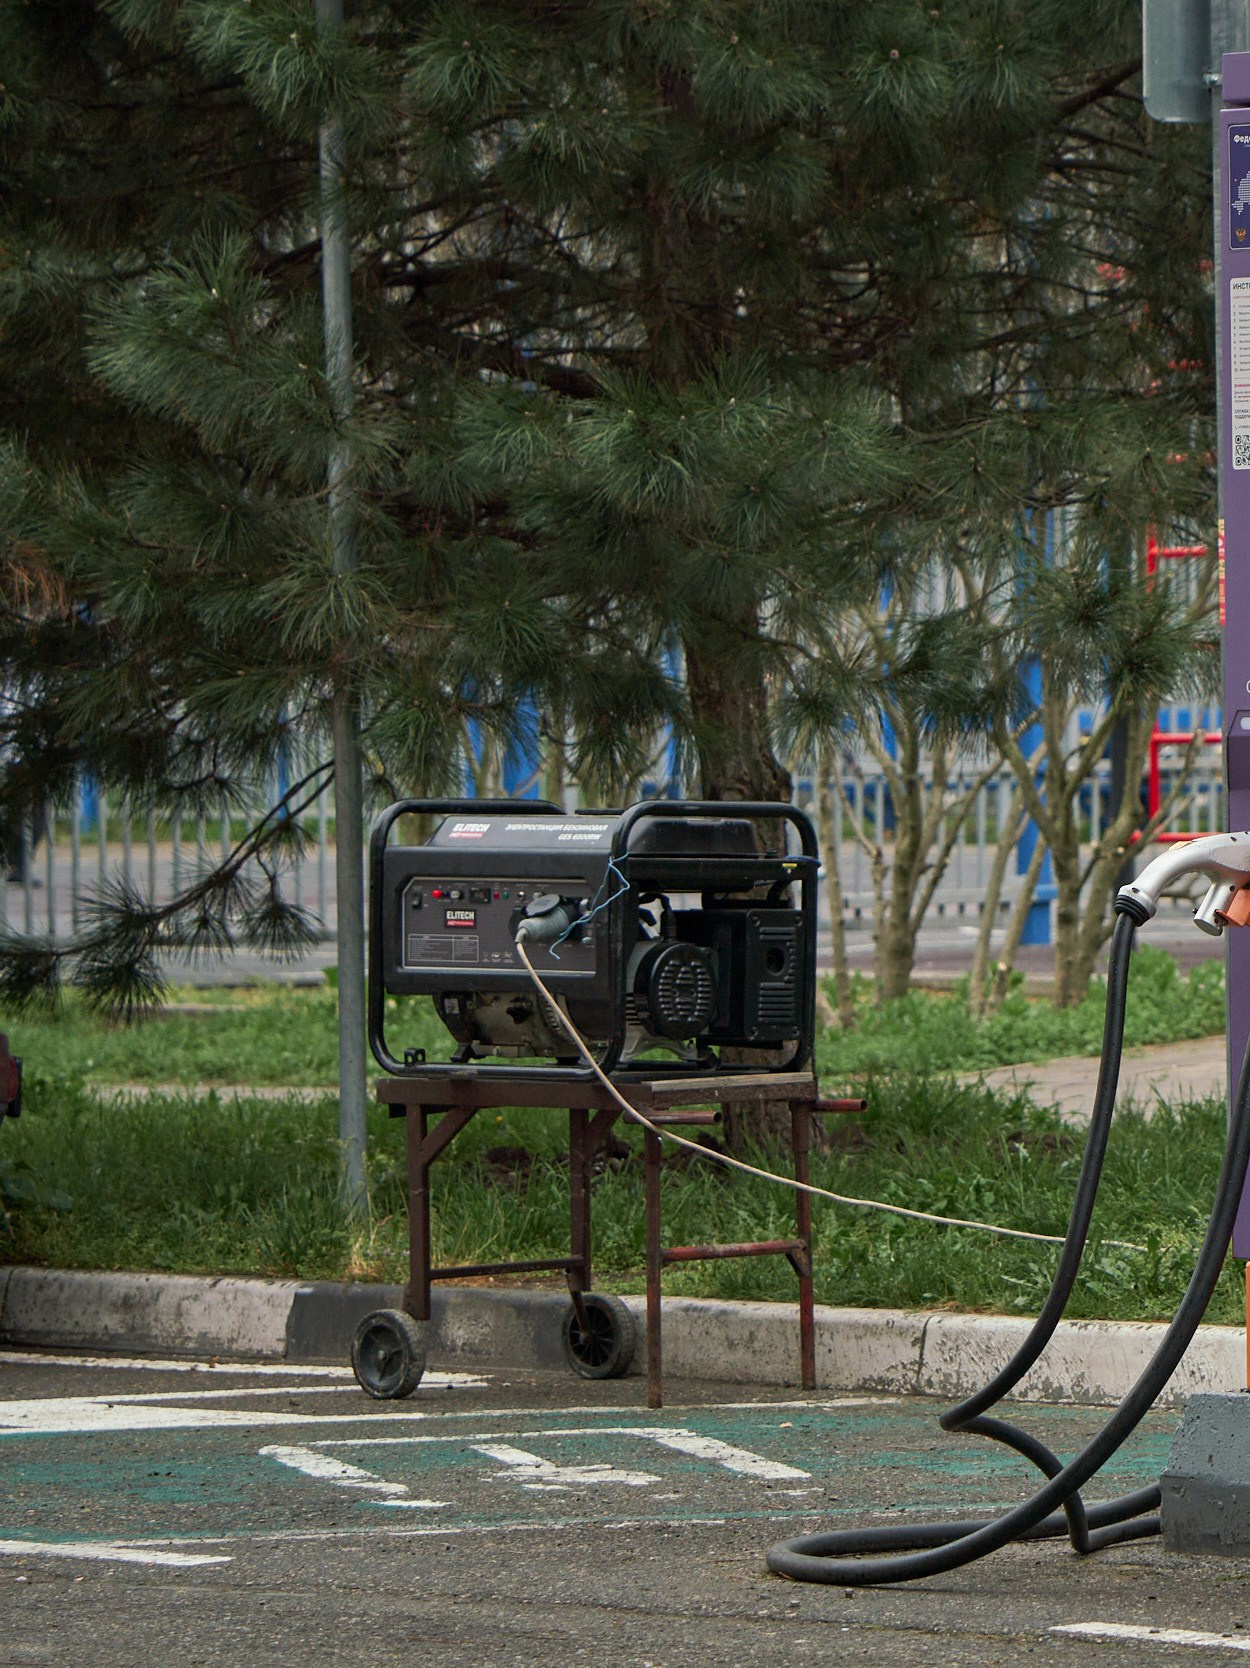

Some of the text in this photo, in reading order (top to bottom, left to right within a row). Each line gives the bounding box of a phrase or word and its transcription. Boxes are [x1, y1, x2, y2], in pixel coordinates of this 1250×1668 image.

[452, 823, 491, 832] ELITECH
[505, 823, 608, 832] ЭЛЕКТРОСТАНЦИЯ БЕНЗИНОВАЯ
[557, 833, 572, 841] GES
[446, 910, 475, 920] ELITECH
